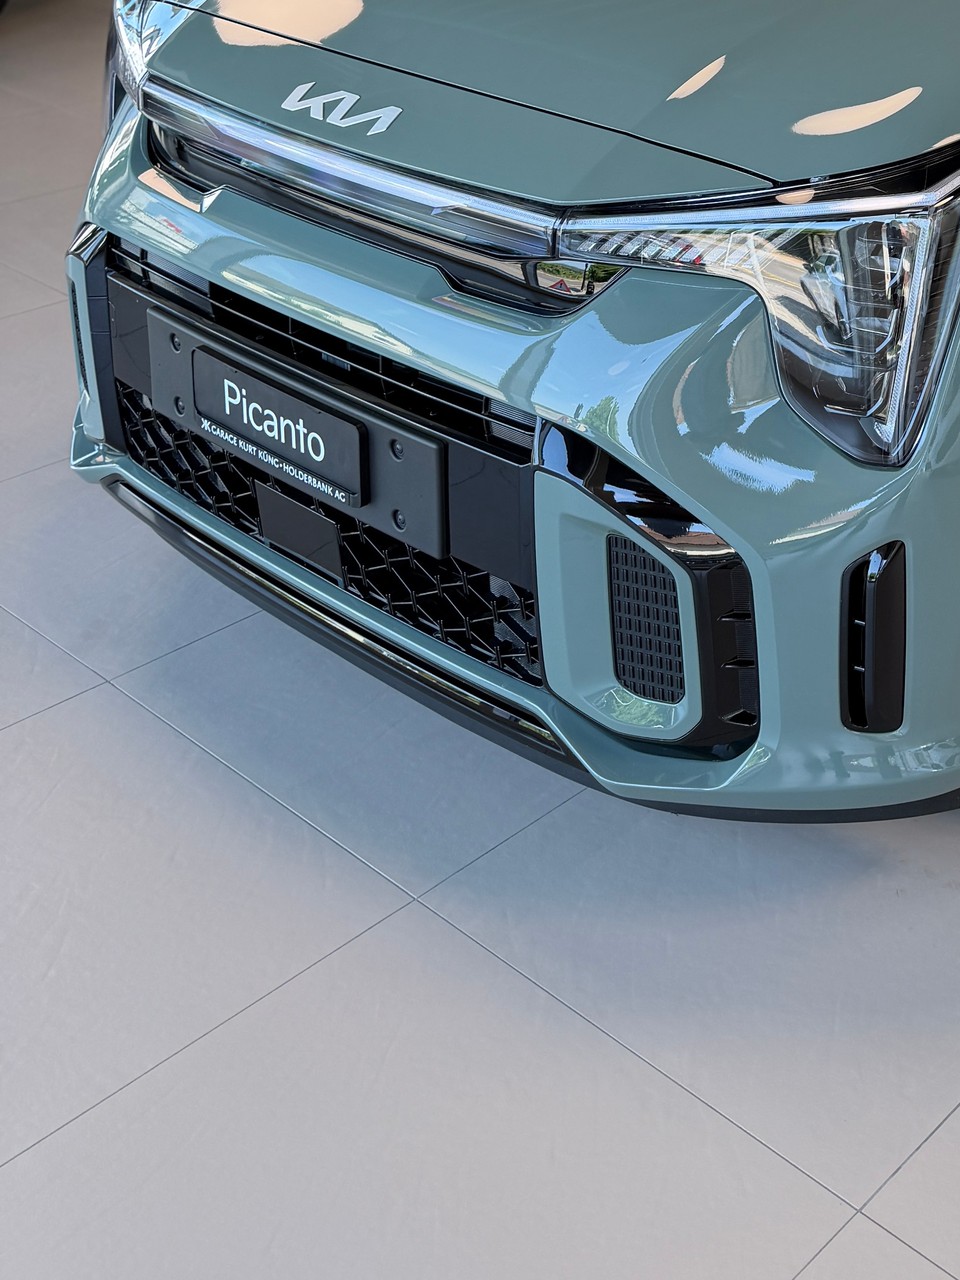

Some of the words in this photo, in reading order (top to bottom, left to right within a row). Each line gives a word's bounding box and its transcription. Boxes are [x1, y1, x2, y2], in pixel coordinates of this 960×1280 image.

[281, 81, 403, 135] KIA
[223, 378, 325, 462] Picanto
[211, 425, 238, 446] GARAGE
[238, 439, 257, 456] KURT
[334, 489, 346, 503] AG
